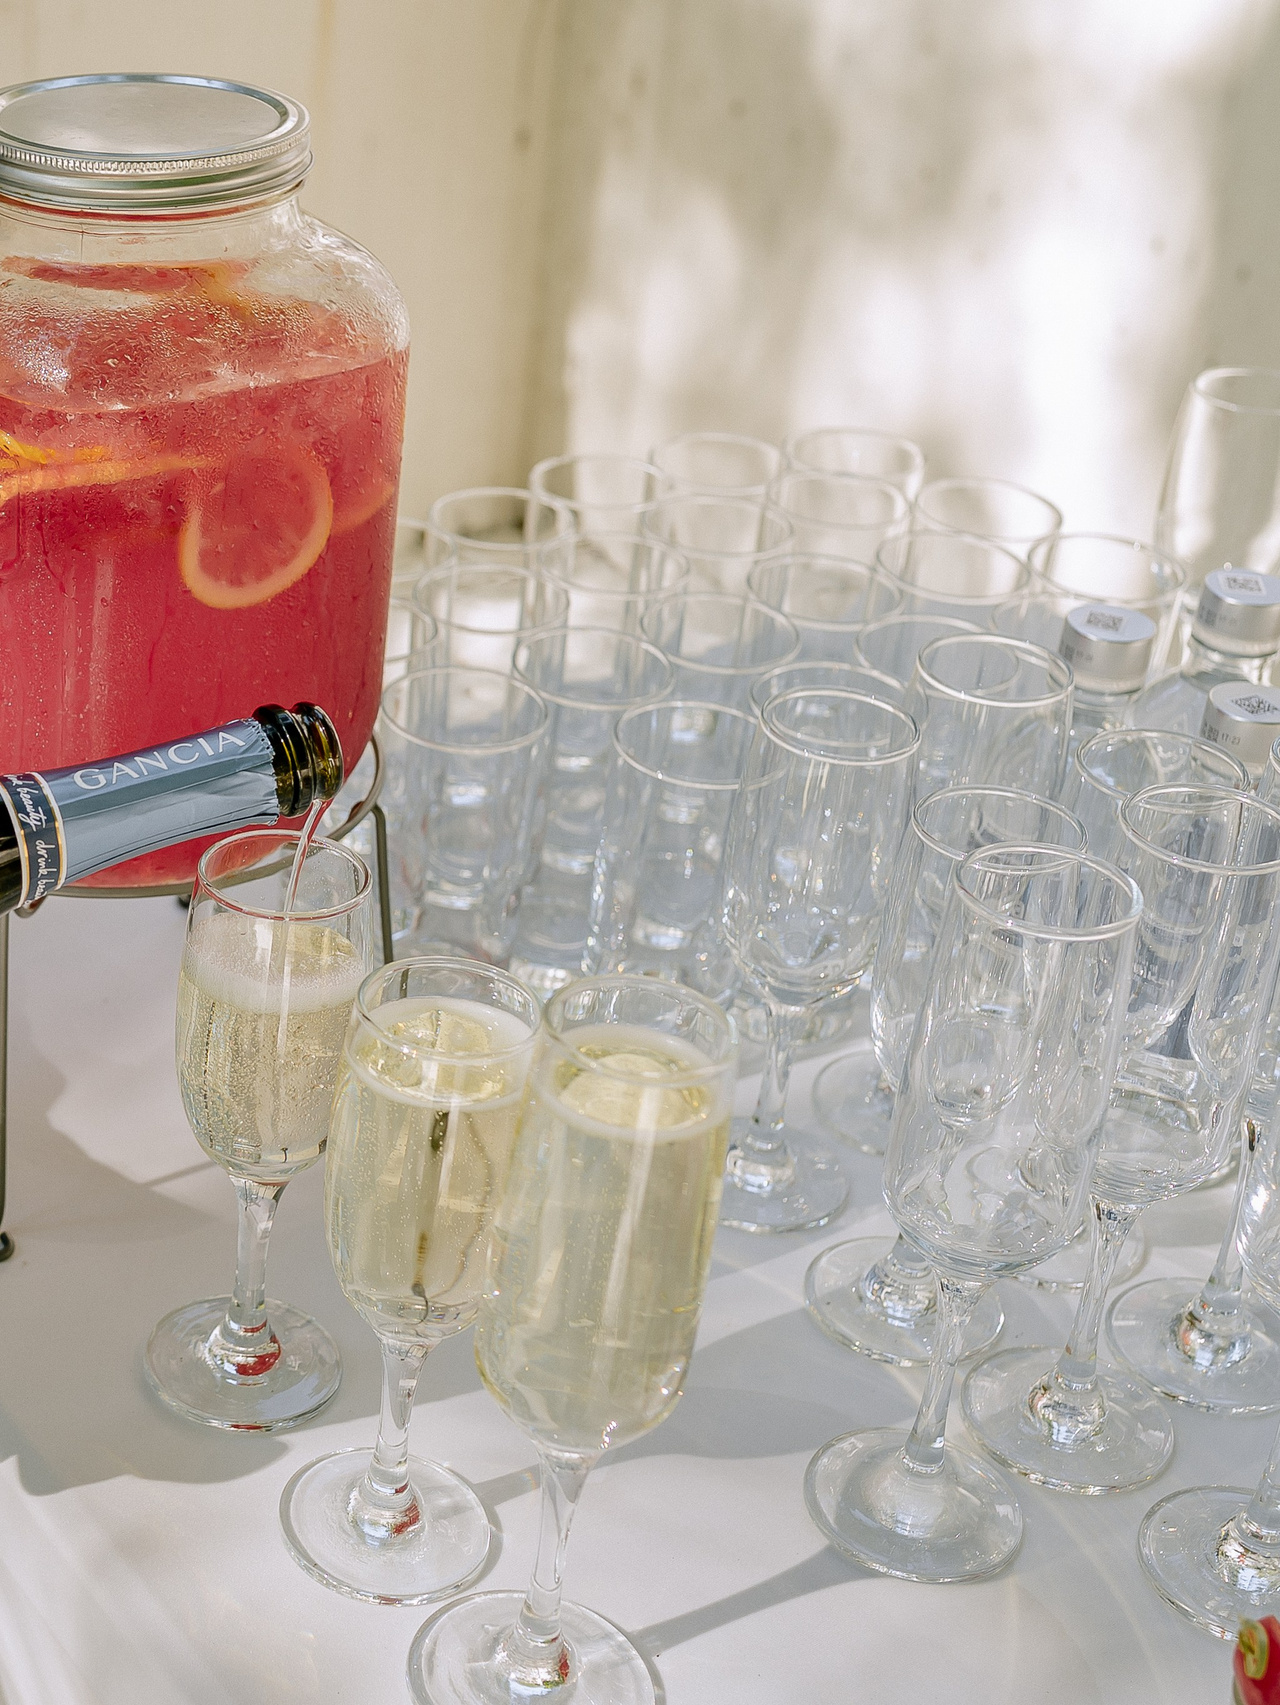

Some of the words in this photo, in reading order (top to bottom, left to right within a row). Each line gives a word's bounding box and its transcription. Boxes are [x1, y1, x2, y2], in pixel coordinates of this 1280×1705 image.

[73, 731, 246, 790] GANCIA
[17, 787, 48, 832] beauty
[35, 839, 58, 878] drink
